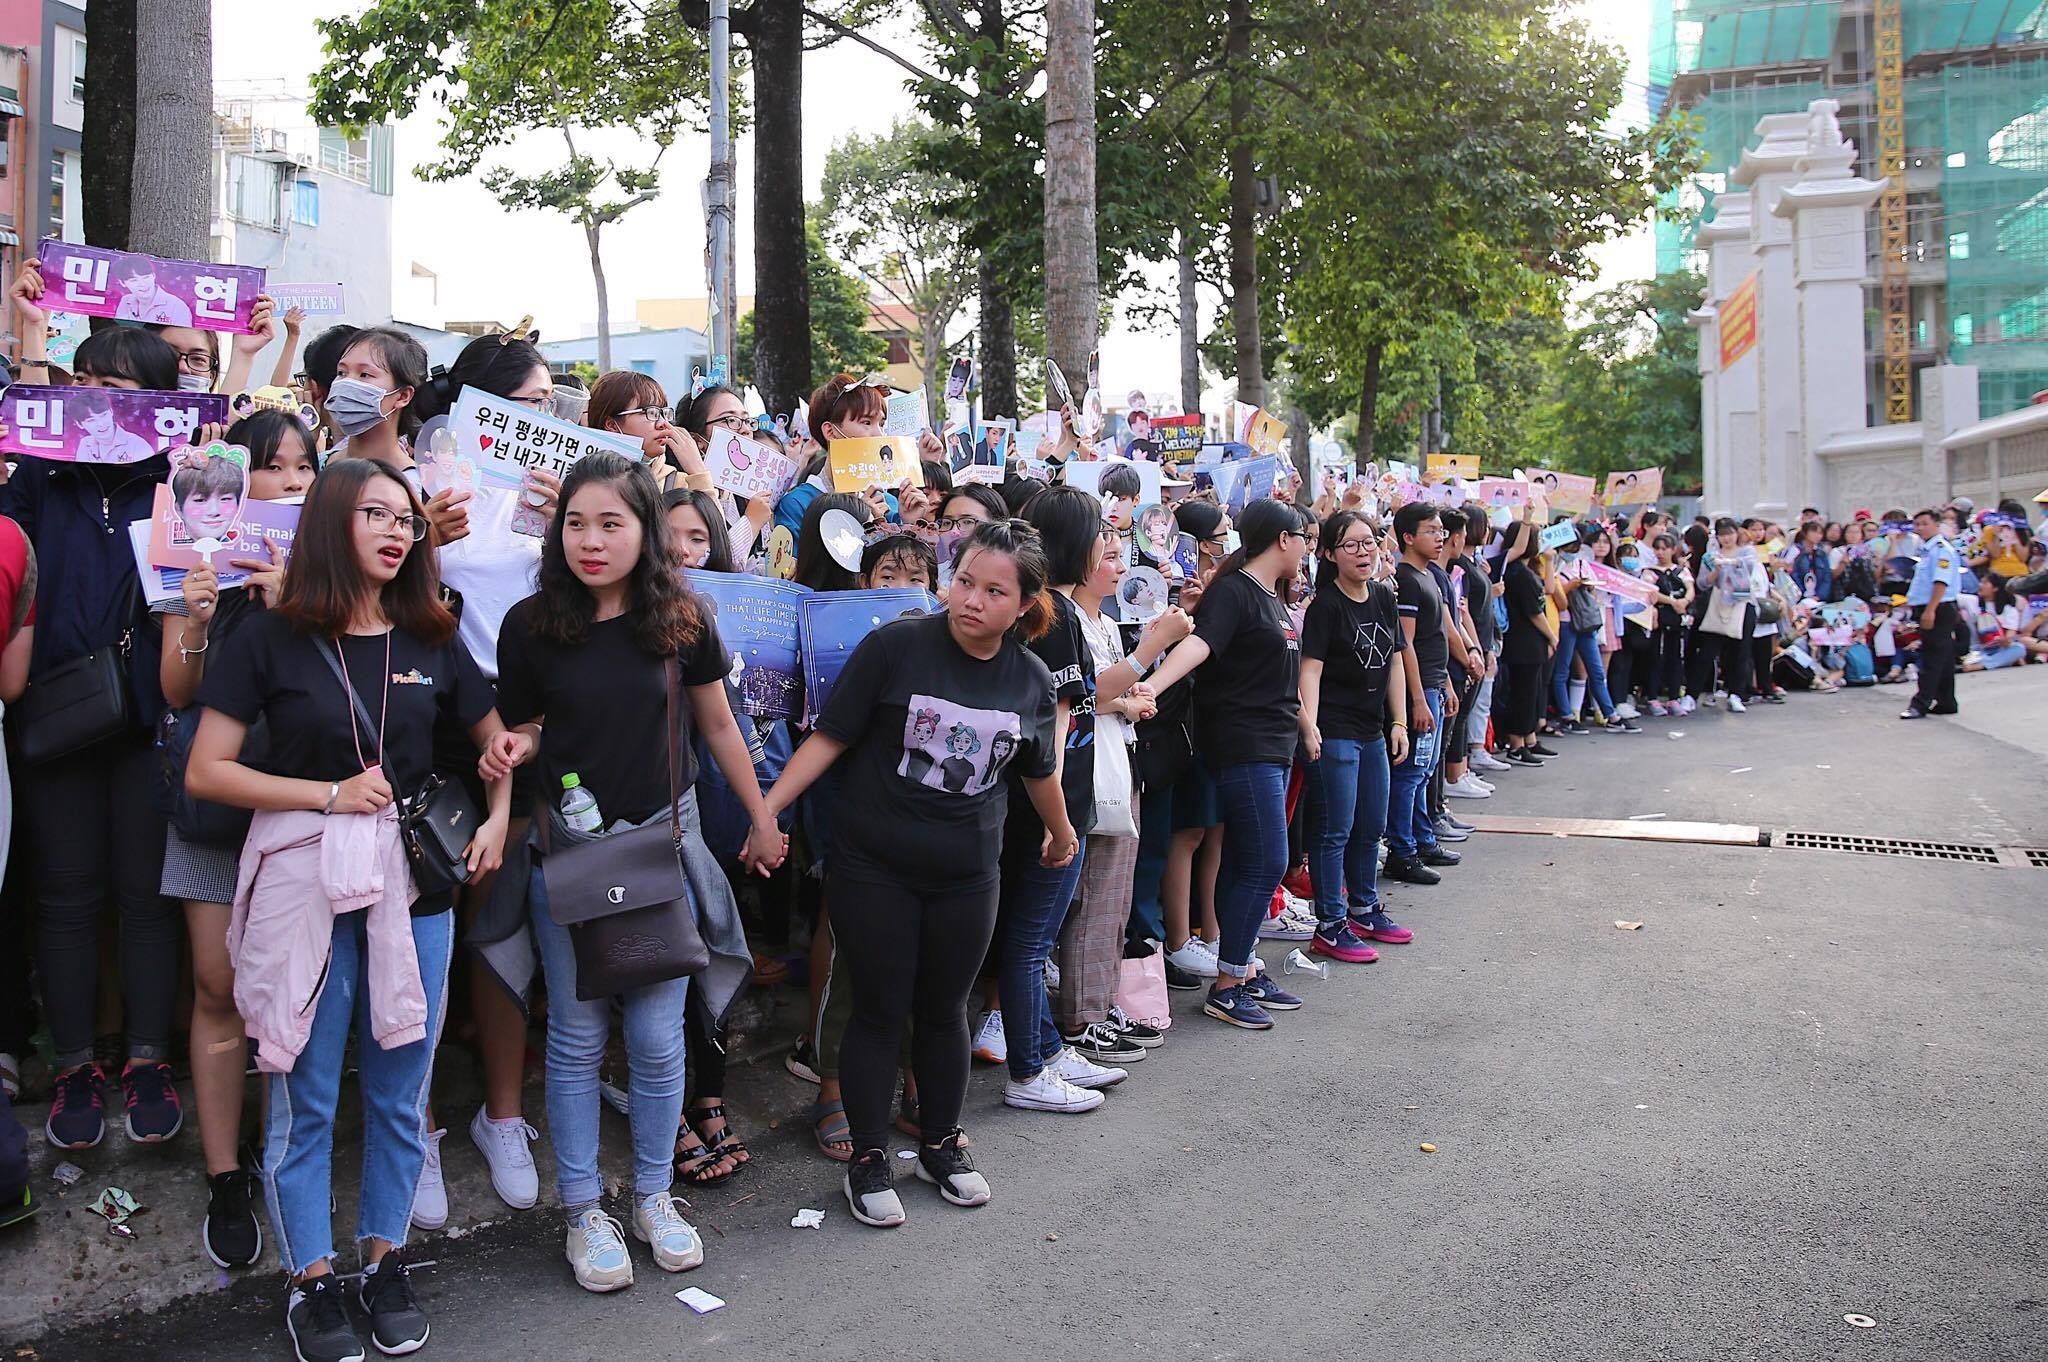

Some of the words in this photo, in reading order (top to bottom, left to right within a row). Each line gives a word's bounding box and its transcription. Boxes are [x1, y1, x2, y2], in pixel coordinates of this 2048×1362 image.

[63, 255, 110, 305] 민
[194, 276, 237, 321] 현
[273, 296, 337, 310] VENTEEN
[16, 399, 63, 449] 민
[475, 406, 510, 434] 우리
[494, 438, 511, 461] 넌
[513, 445, 546, 467] 내가
[719, 467, 745, 487] 우리
[240, 521, 262, 536] NE
[266, 528, 296, 540] mak
[240, 539, 260, 552] be
[737, 596, 754, 604] THAT
[726, 604, 750, 613] THAT
[754, 606, 770, 617] LIFE
[774, 609, 790, 620] TIME
